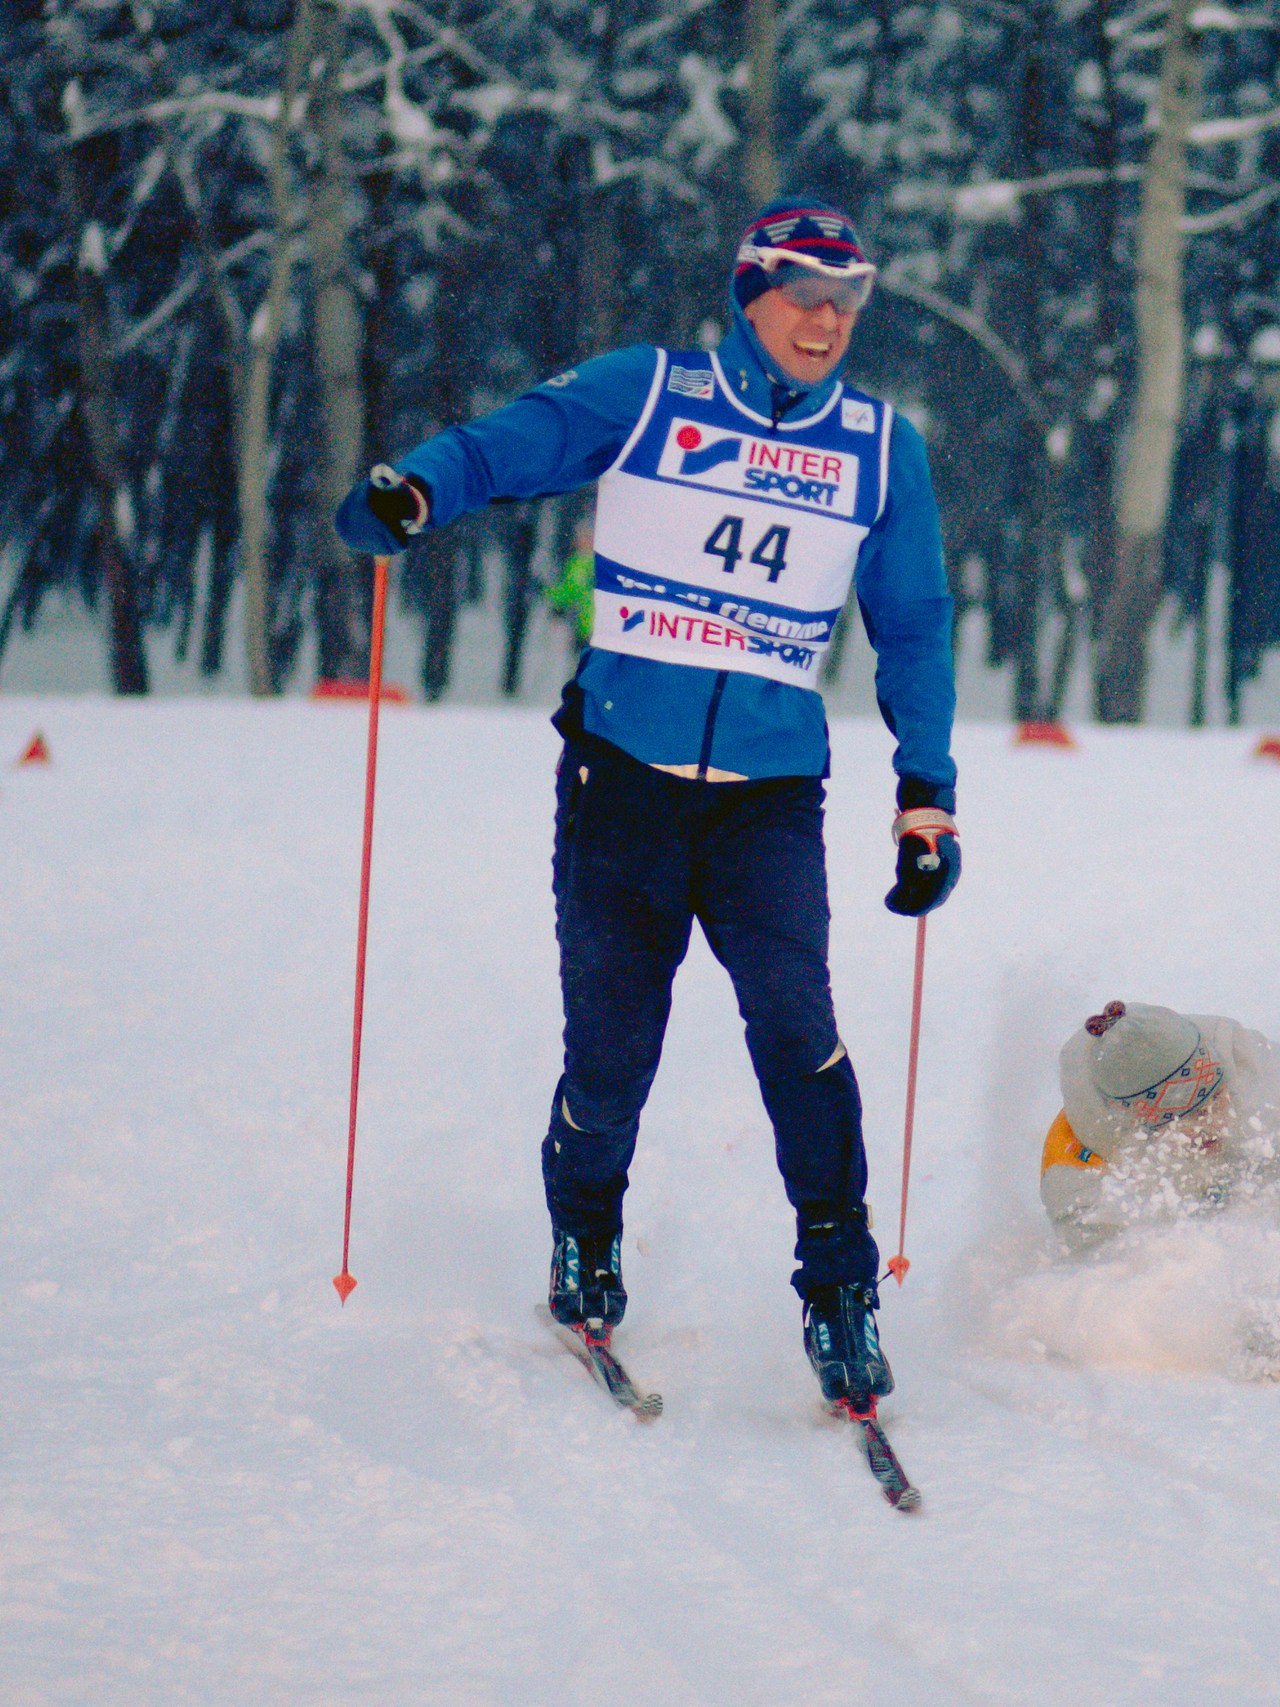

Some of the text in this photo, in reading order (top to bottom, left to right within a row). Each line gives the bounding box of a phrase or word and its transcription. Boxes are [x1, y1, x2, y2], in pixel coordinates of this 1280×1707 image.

[748, 442, 843, 483] INTER
[743, 468, 839, 507] SPORT
[703, 515, 791, 584] 44
